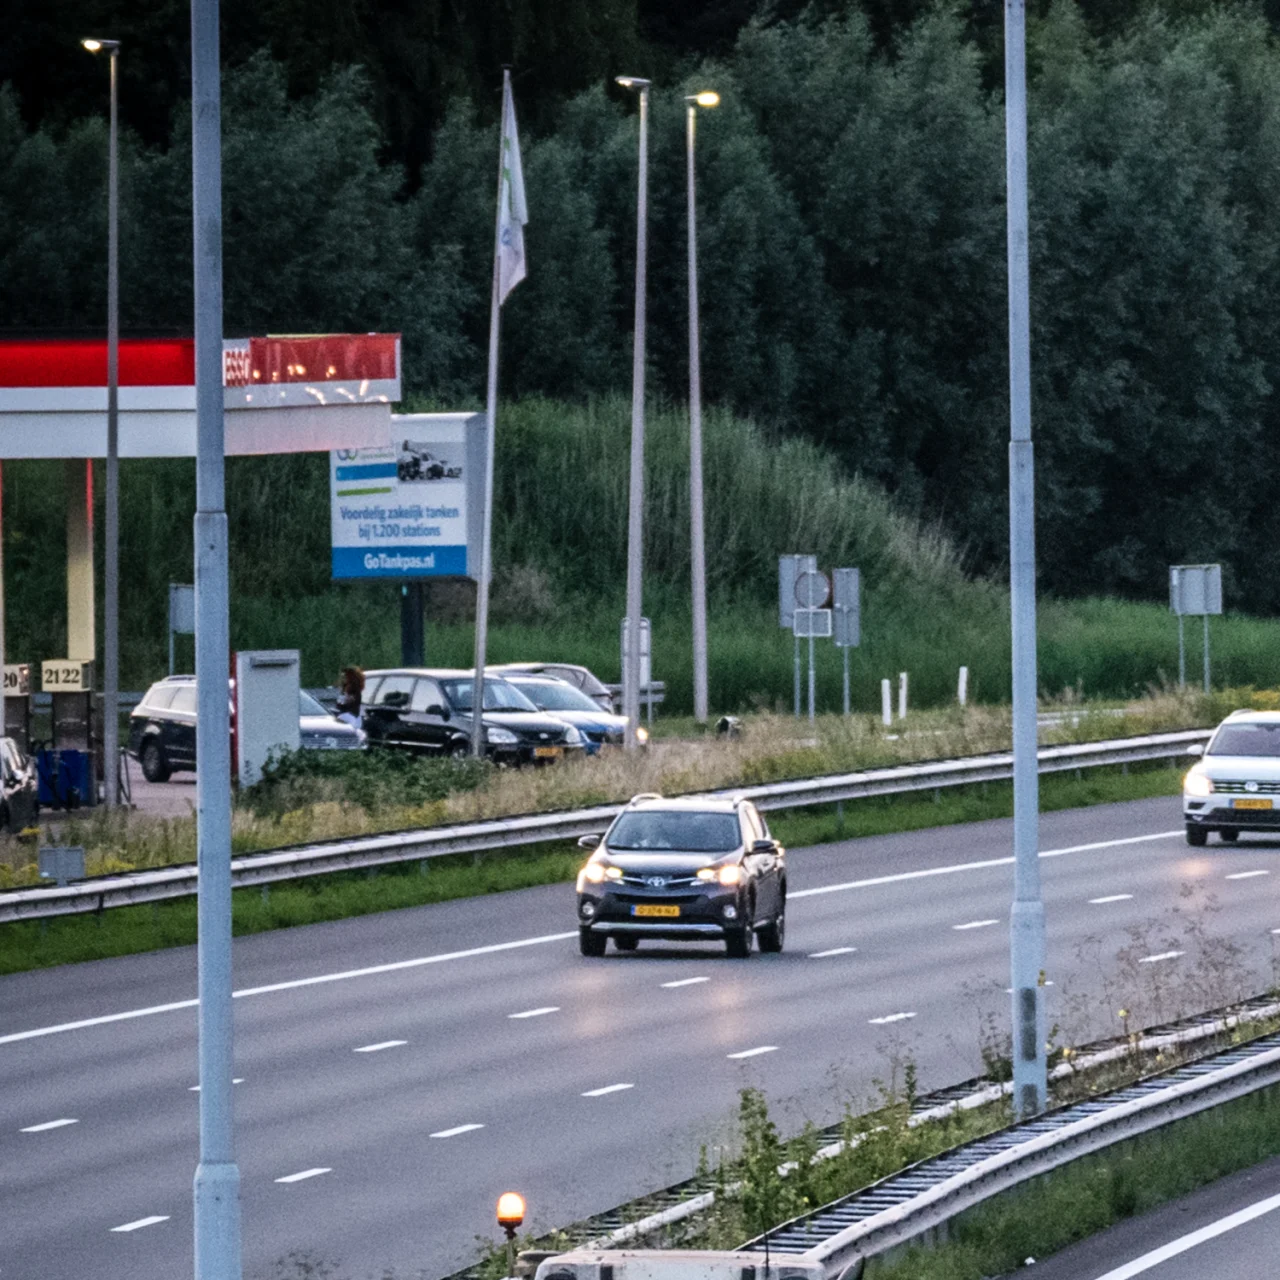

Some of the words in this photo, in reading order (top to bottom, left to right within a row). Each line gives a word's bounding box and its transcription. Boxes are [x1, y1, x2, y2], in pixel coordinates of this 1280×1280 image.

[340, 506, 386, 520] Voordelig
[388, 505, 424, 520] zakelijk
[426, 506, 459, 519] tanken
[358, 524, 371, 540] bij
[372, 524, 400, 538] 1.200
[402, 524, 441, 537] stations
[364, 552, 435, 571] GoTankpas.nl
[44, 668, 59, 684] 21
[62, 668, 80, 684] 22
